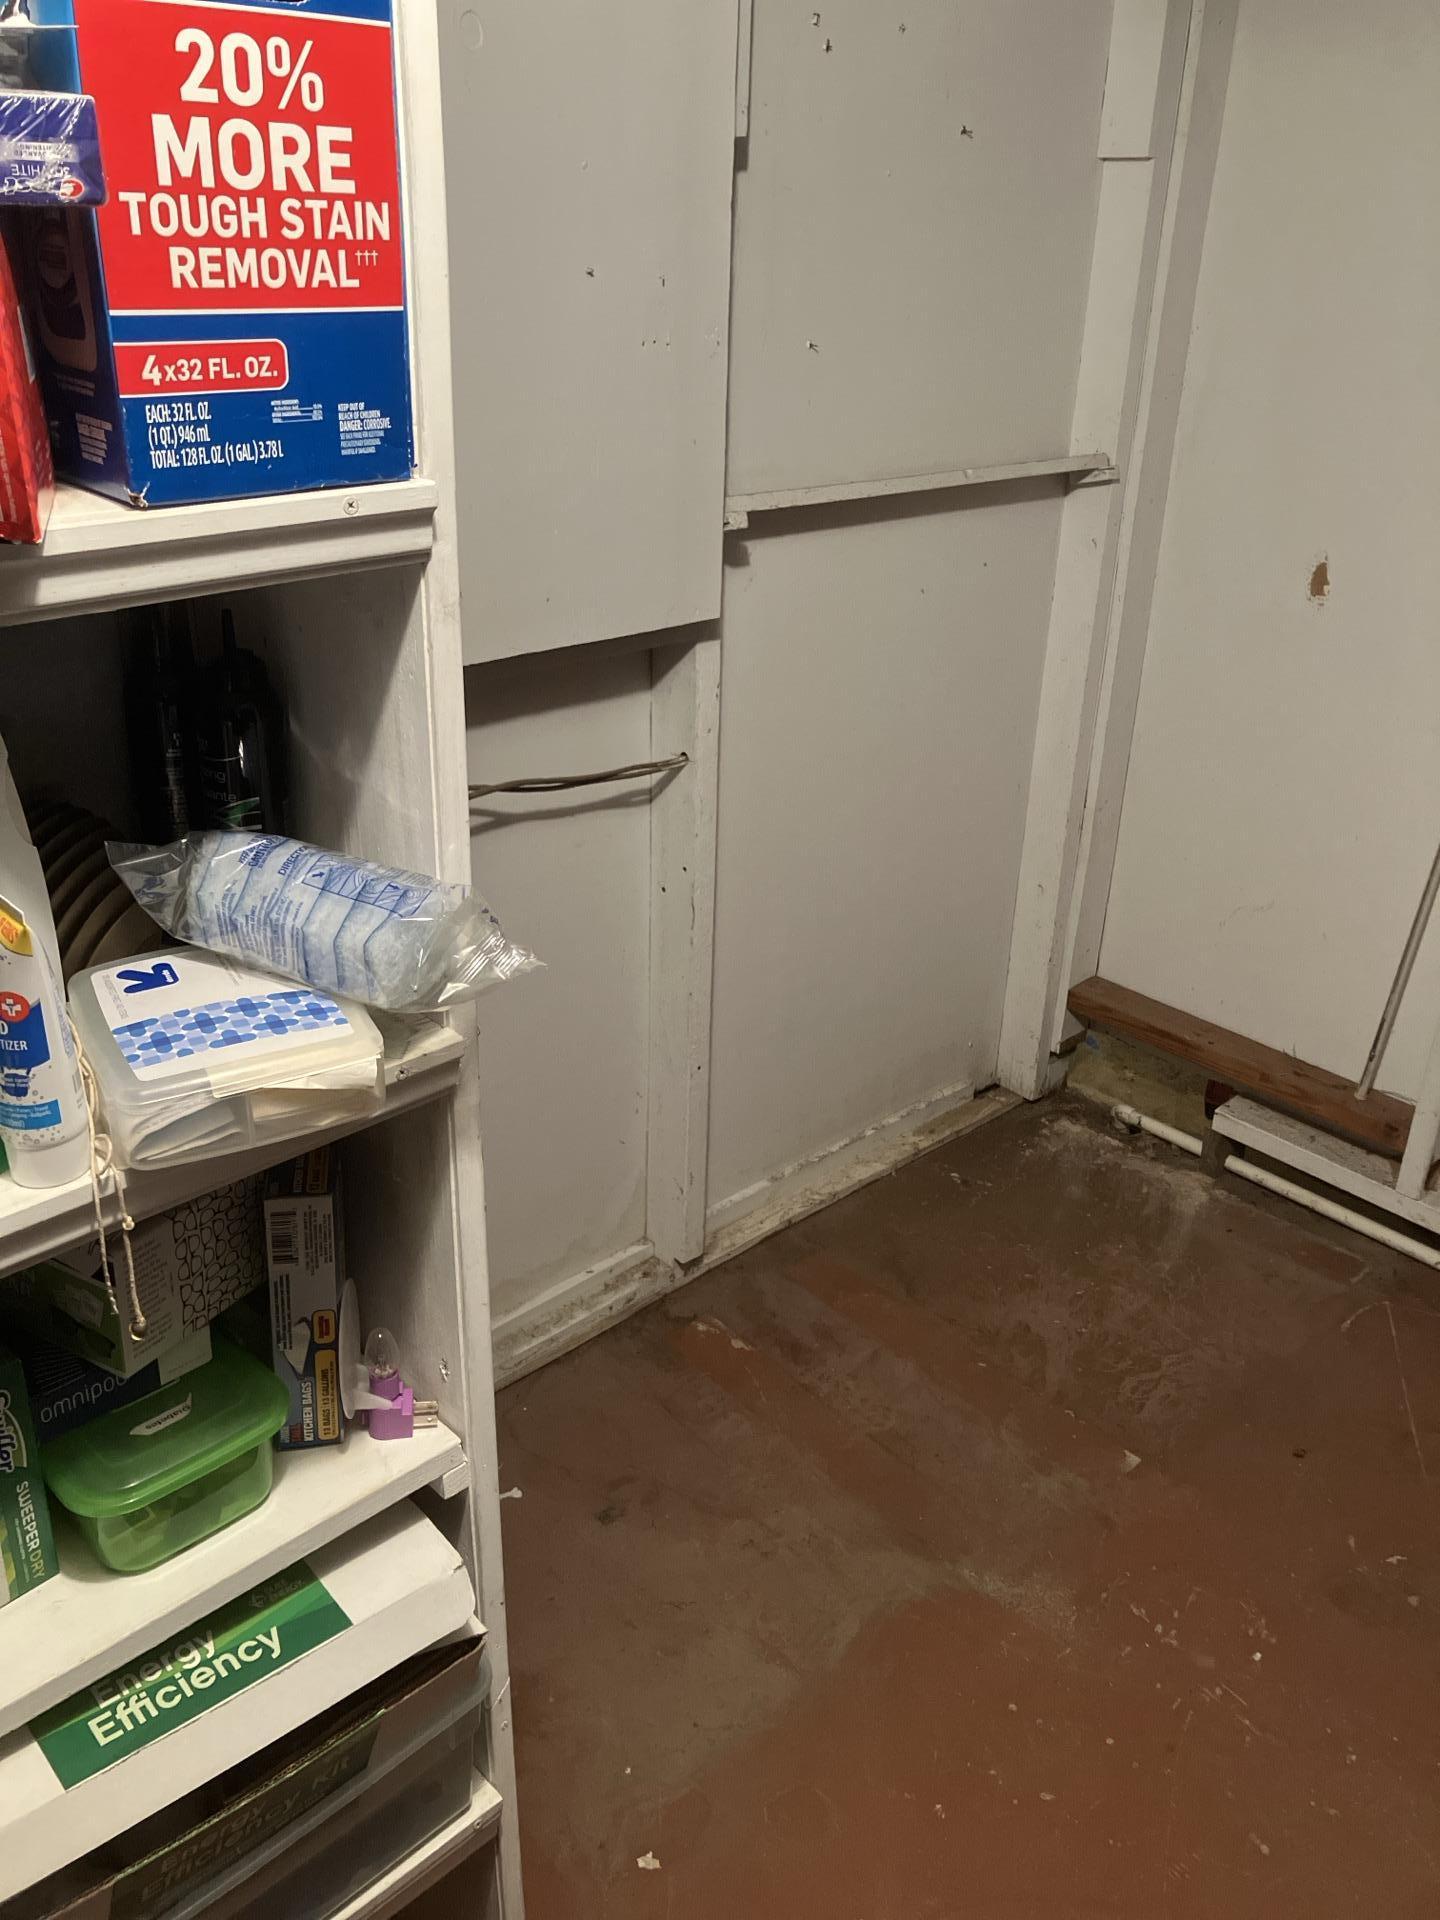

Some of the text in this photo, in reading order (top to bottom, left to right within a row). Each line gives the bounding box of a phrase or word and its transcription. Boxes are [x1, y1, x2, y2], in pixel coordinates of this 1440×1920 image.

[174, 27, 325, 113] 20%
[150, 113, 357, 195] MORE
[118, 190, 391, 242] TOUGH STAIN
[208, 357, 242, 381] FL.
[244, 354, 279, 379] OZ.
[145, 401, 212, 424] EACH: 32 FL. OZ.
[148, 424, 158, 451] (1
[178, 424, 196, 444] 946
[196, 424, 211, 443] mL
[339, 419, 364, 432] DANGER:
[150, 449, 180, 470] TOTAL:
[180, 447, 197, 467] 128
[225, 441, 235, 467] (1
[258, 440, 278, 460] 3.78
[277, 439, 285, 458] L
[301, 1381, 315, 1442] KITCHEN BAGS
[16, 1480, 40, 1551] SWEEPER
[29, 1548, 46, 1579] DRY
[86, 1625, 282, 1748] Efficiency
[88, 1629, 218, 1710] Energy
